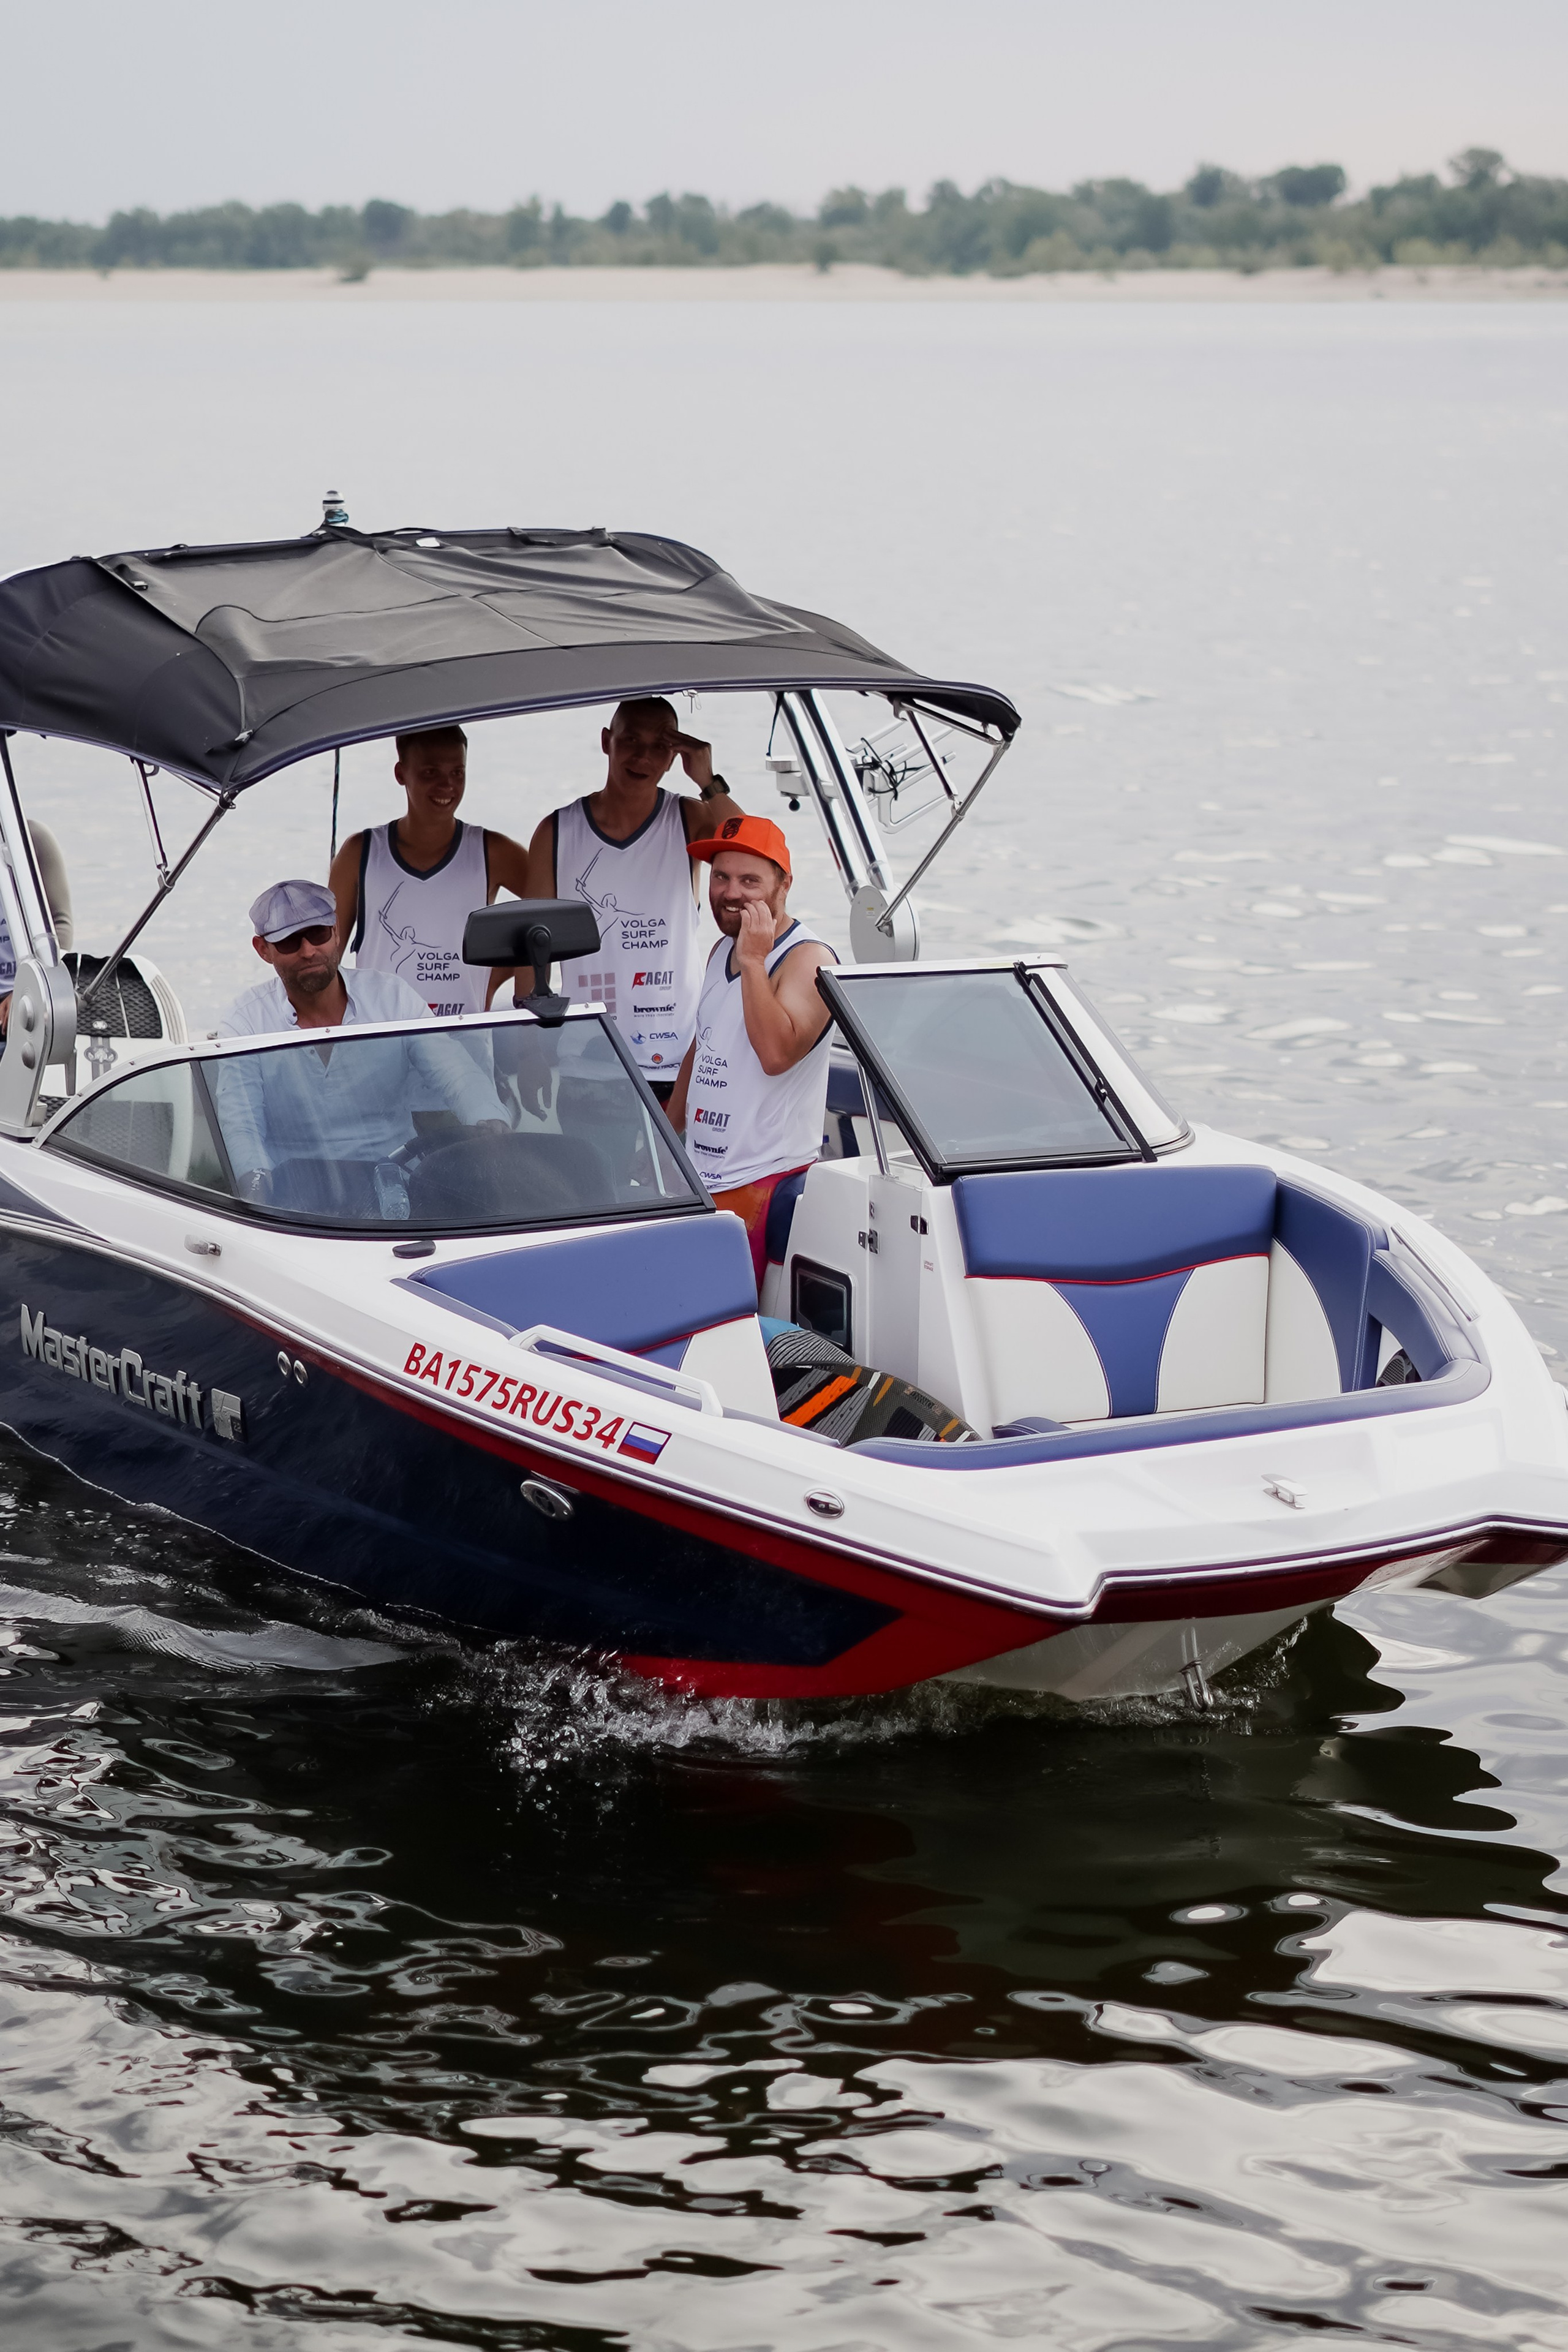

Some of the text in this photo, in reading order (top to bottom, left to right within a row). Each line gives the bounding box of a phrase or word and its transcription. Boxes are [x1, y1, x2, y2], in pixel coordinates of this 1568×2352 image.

[620, 918, 666, 929] VOLGA
[621, 930, 656, 939] SURF
[622, 940, 668, 949] CHAMP
[417, 973, 461, 981] CHAMP
[701, 1054, 728, 1068] VOLGA
[698, 1065, 718, 1076] SURF
[696, 1075, 728, 1088] CHAMP
[699, 1171, 722, 1180] CWSA
[21, 1303, 204, 1430] MasterCraft
[403, 1342, 625, 1449] BA1575RUS34
